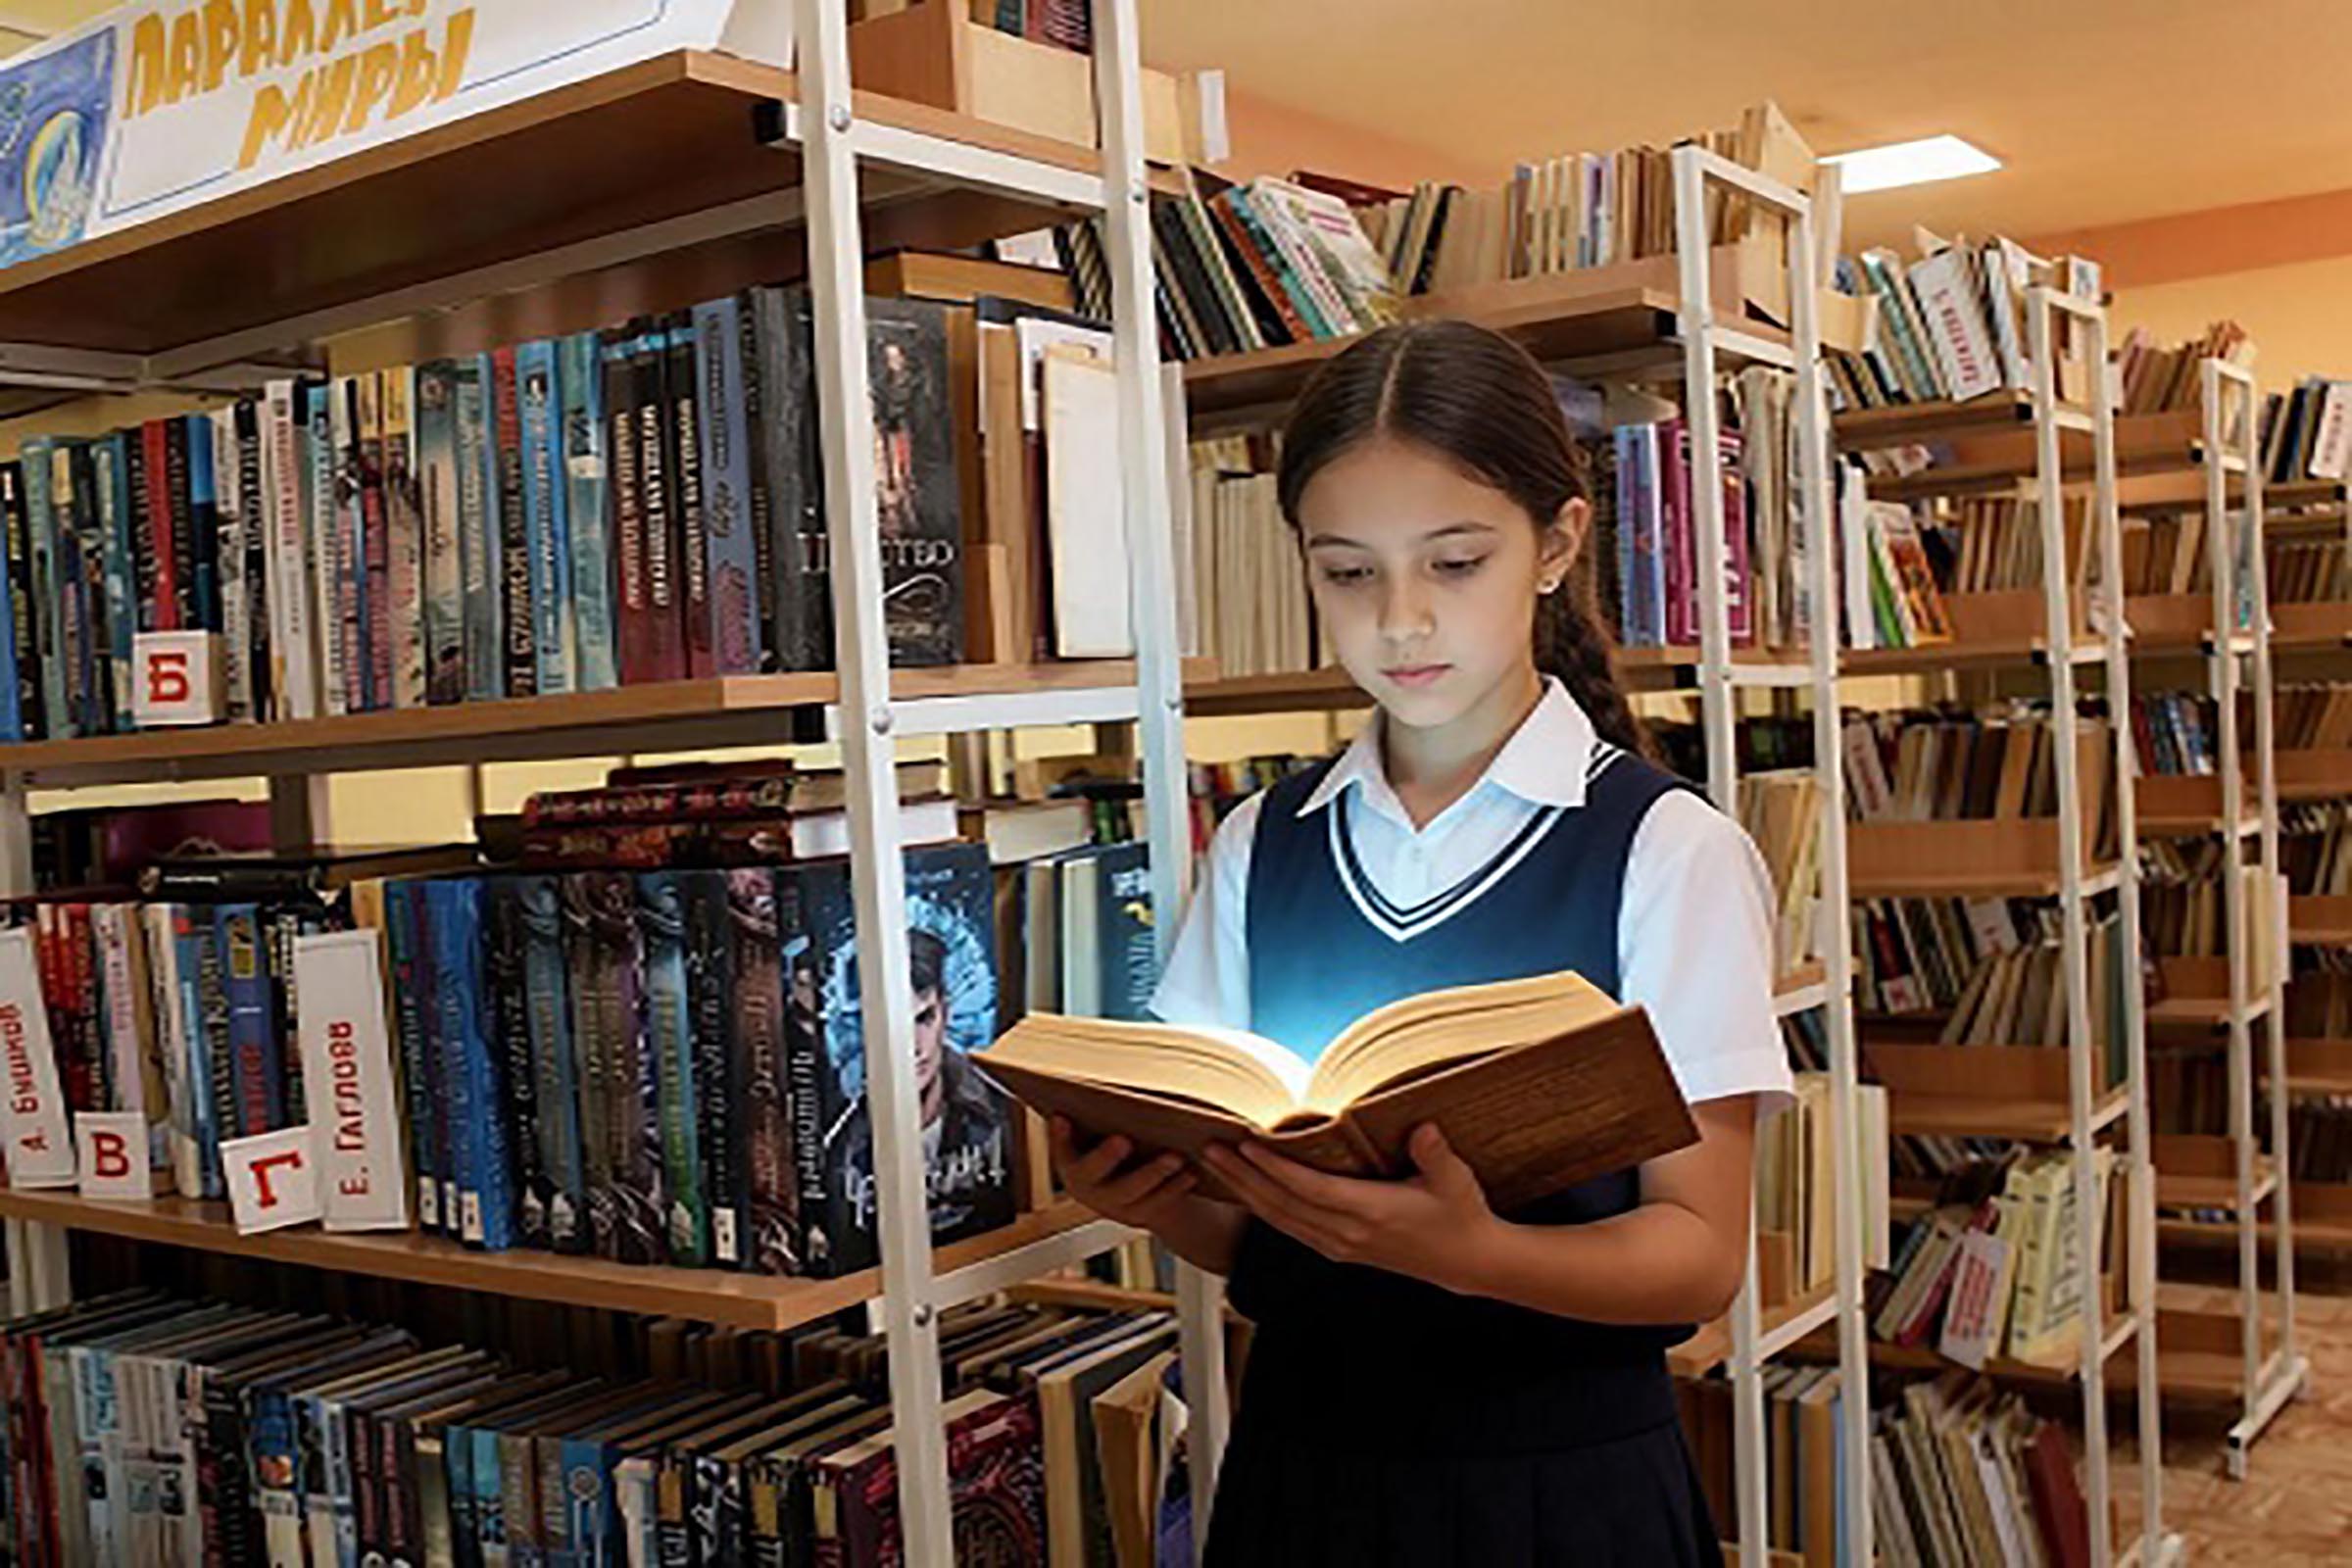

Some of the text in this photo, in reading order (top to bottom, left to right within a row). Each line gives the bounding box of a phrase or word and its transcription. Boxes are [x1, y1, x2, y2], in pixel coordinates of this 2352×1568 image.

[122, 0, 425, 119] ПАРАЛЛ
[237, 8, 474, 171] МИРЫ
[148, 654, 189, 703] Б
[91, 1131, 130, 1178] В
[249, 1150, 302, 1208] Г
[339, 1166, 368, 1196] Е.
